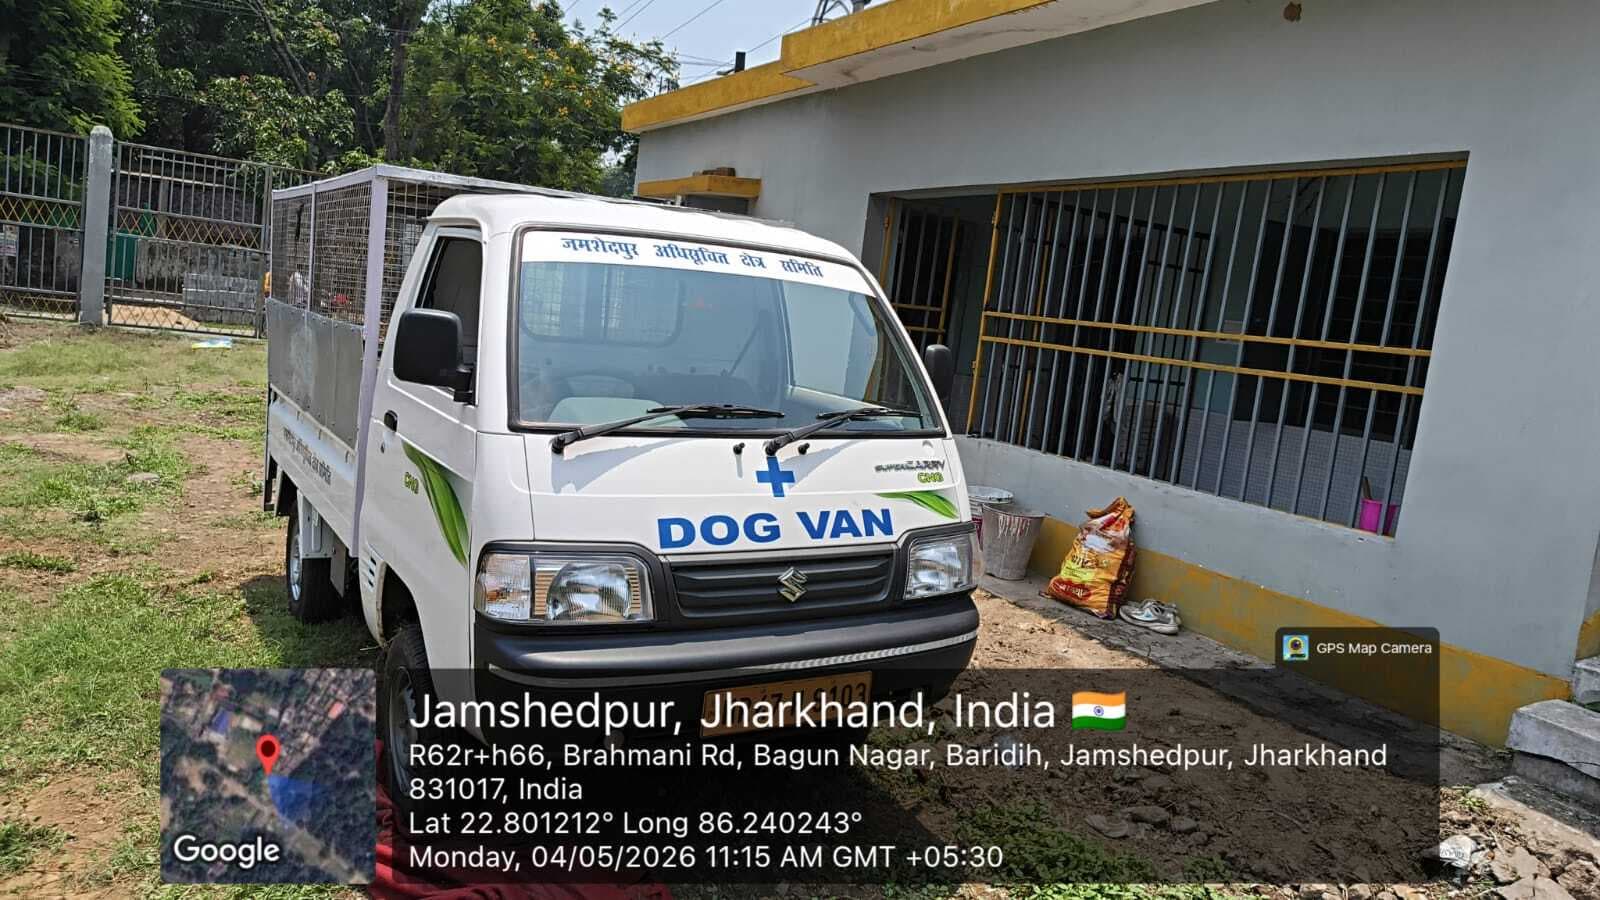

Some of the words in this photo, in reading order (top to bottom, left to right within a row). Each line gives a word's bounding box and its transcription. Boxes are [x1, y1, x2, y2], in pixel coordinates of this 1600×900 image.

[561, 237, 639, 259] जमशेदपुर
[780, 259, 823, 277] समिति
[657, 513, 781, 550] DOG
[797, 508, 893, 540] VAN
